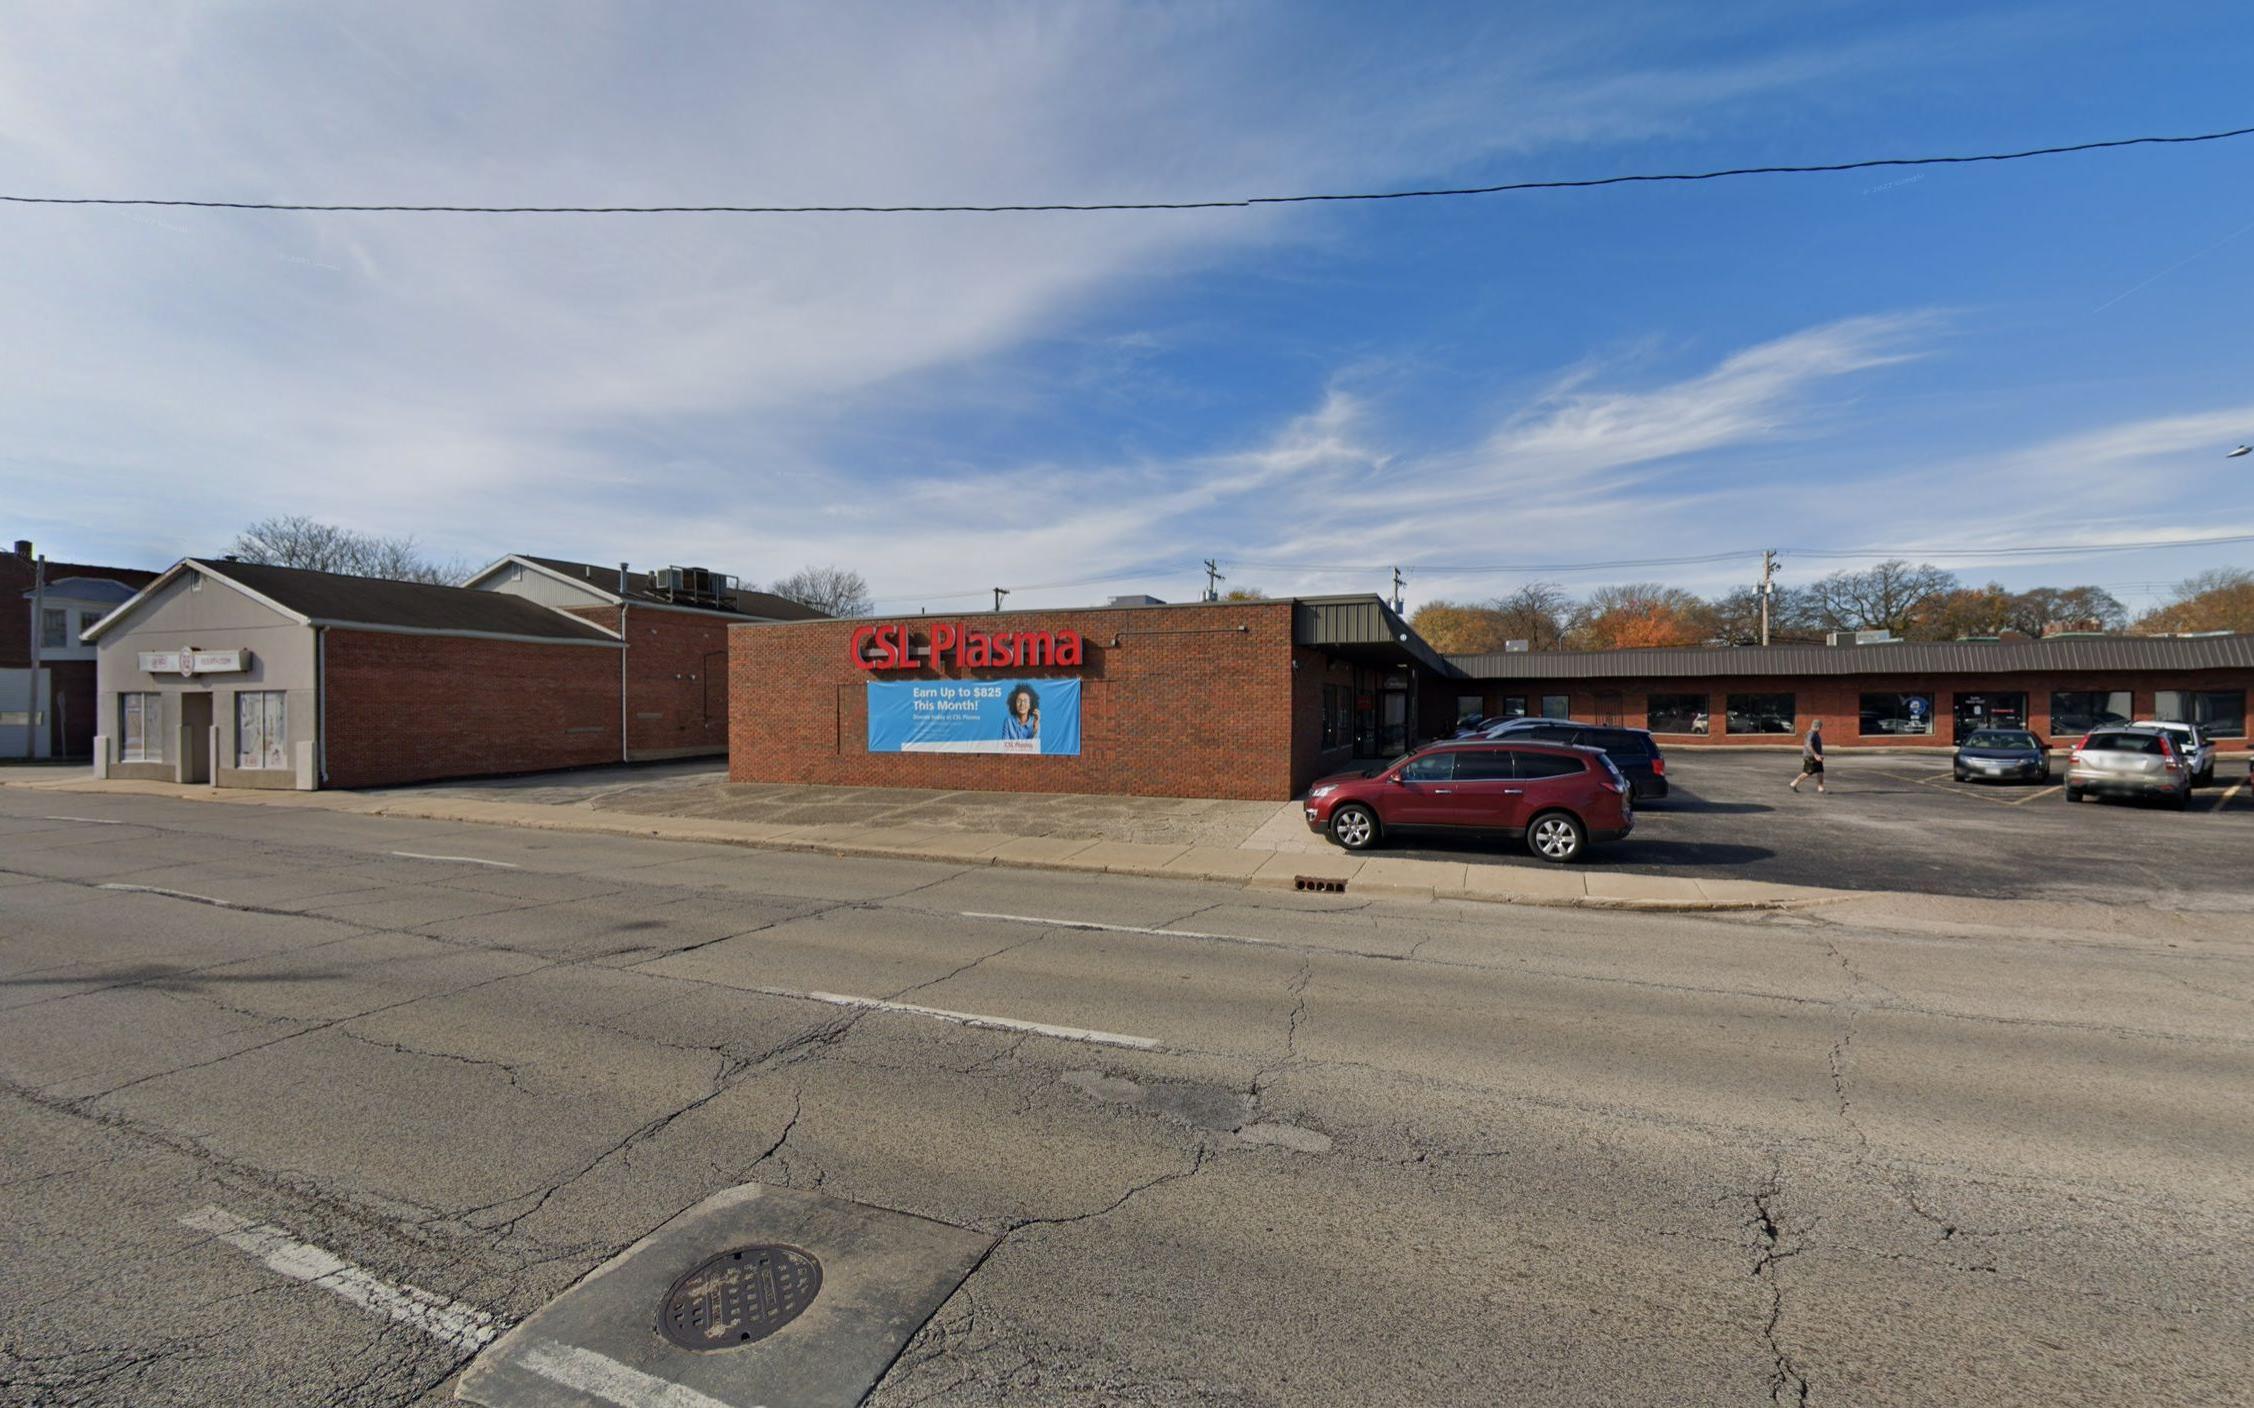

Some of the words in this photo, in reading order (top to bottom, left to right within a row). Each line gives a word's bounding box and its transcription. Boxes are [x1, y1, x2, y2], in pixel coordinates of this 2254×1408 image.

[851, 625, 920, 670] CSL
[930, 623, 1082, 668] Plasma
[913, 687, 937, 698] Earn
[940, 687, 956, 699] Up
[958, 687, 971, 697] to
[973, 687, 1002, 698] $825
[913, 700, 934, 711] This
[937, 700, 978, 711] Month!
